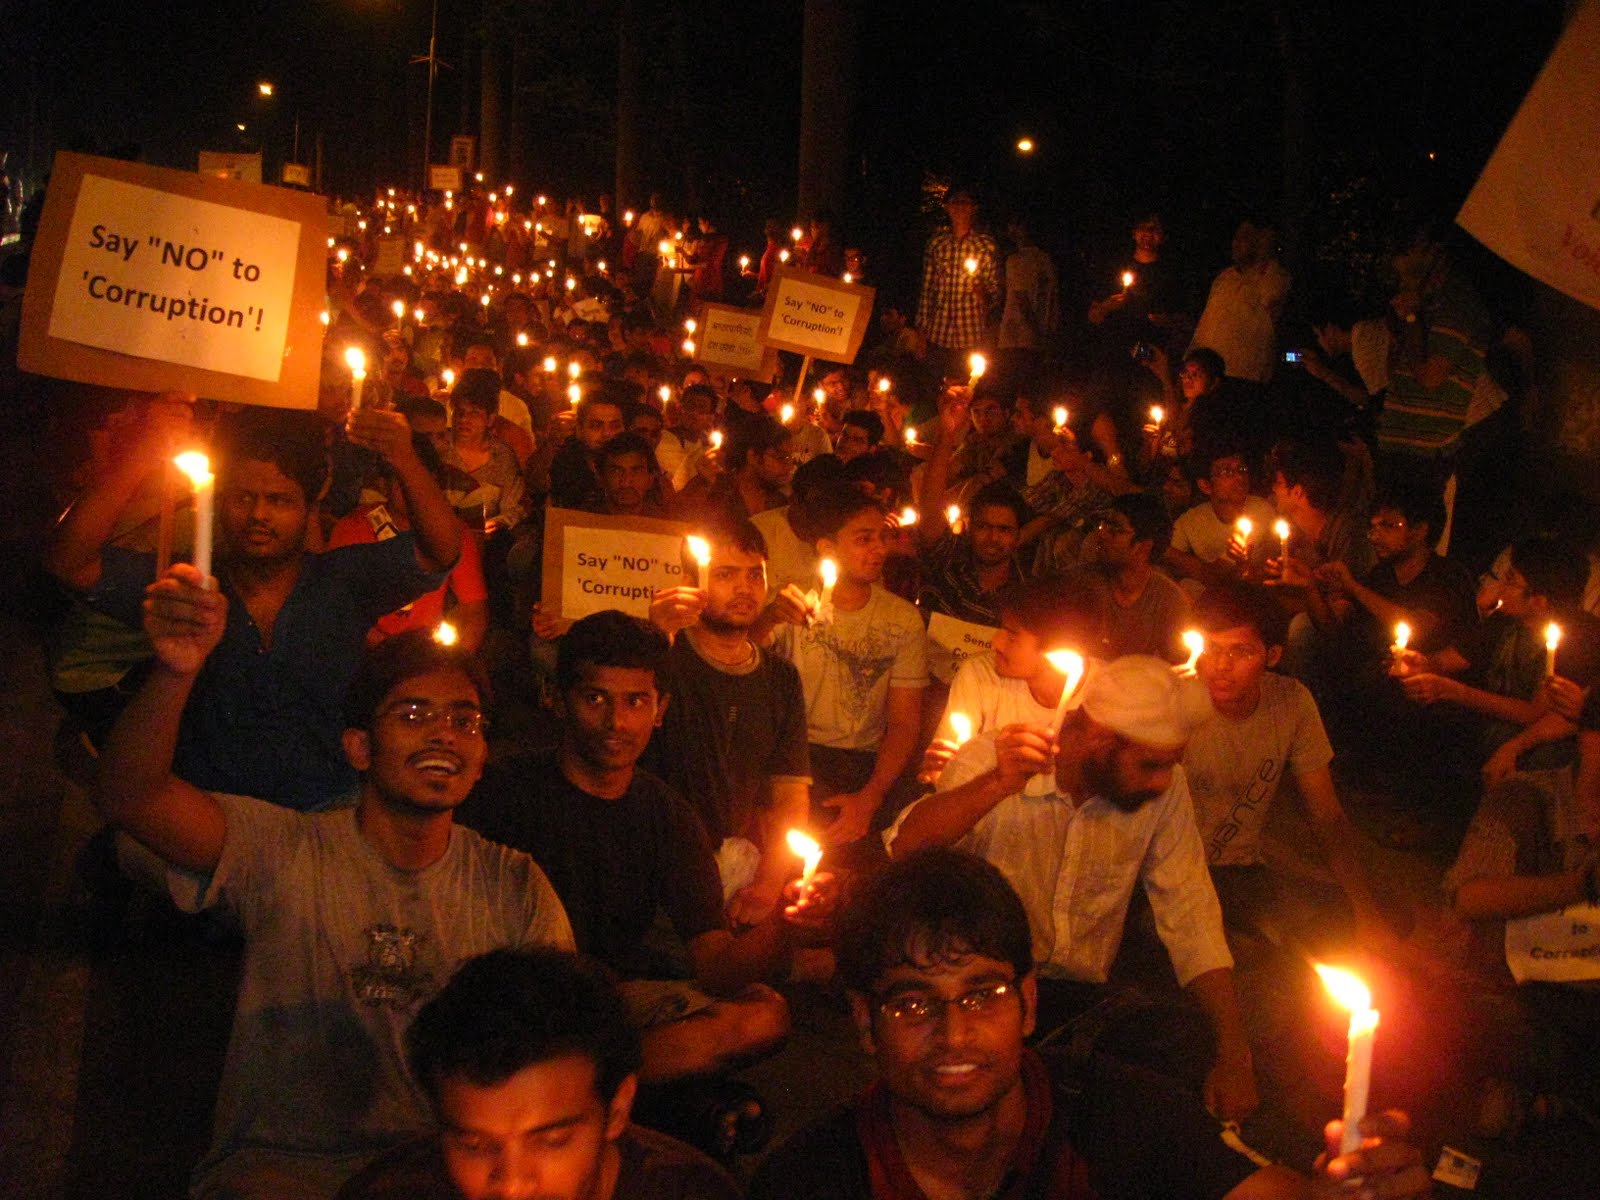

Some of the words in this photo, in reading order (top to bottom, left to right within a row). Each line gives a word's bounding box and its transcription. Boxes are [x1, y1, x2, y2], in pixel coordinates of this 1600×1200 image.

[89, 225, 139, 261] Say
[149, 235, 224, 272] "NO"
[232, 258, 260, 282] to
[83, 271, 264, 332] 'Corruption'!
[784, 296, 803, 311] Say
[806, 301, 832, 315] "NO"
[834, 307, 845, 318] to
[781, 314, 843, 336] 'Corruption'!
[577, 552, 608, 571] Say
[613, 555, 658, 572] "NO"
[664, 562, 681, 575] to
